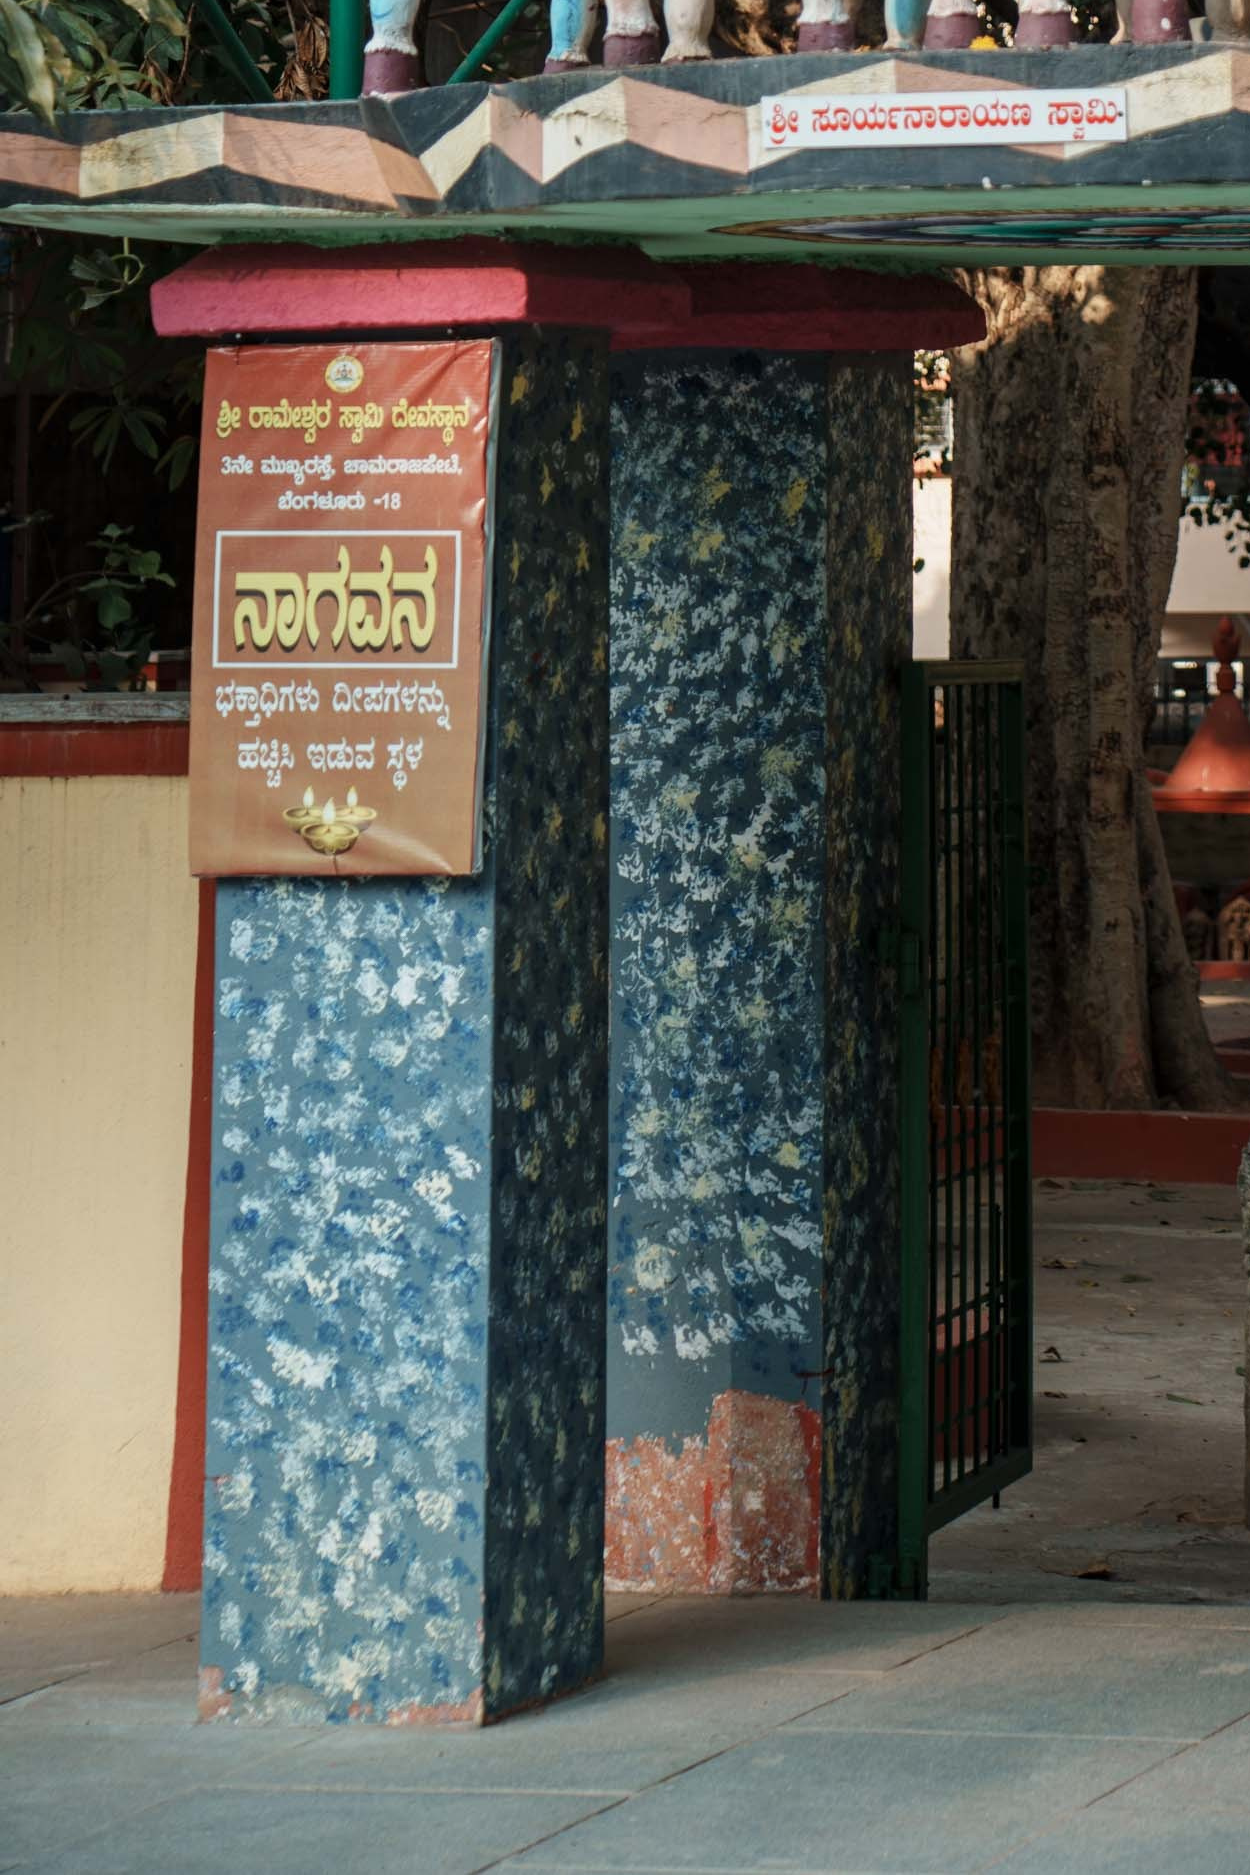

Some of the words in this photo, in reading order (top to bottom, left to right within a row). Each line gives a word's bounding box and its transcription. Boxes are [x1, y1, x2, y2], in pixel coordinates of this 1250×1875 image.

[770, 103, 799, 144] ಶ್ರೀ
[812, 96, 1032, 132] ಸೂರ್ಯನಾರಾಯಣ
[1048, 98, 1118, 140] ಸ್ವಾಮಿ
[216, 399, 242, 438] ಶ್ರೀ
[248, 398, 332, 444] ರಾಮೇಶ್ವರ
[338, 401, 384, 444] ಸ್ವಾಮಿ
[391, 397, 471, 446] ದೇವಸ್ಥಾನ
[220, 454, 254, 475] 3ನೇ
[277, 489, 366, 511] ಬೆಂಗಳೂರು
[233, 544, 438, 652] ನಾಗವನ
[215, 679, 321, 728] ಭಕ್ತಾಧಿಗಳು
[331, 679, 452, 731] ದೀಪಗಳನ್ನು
[237, 736, 295, 788] ಹಚ್ಚಿಸಿ
[306, 736, 376, 774] ಇಡುವ
[386, 736, 424, 791] ಸ್ಥಳ
